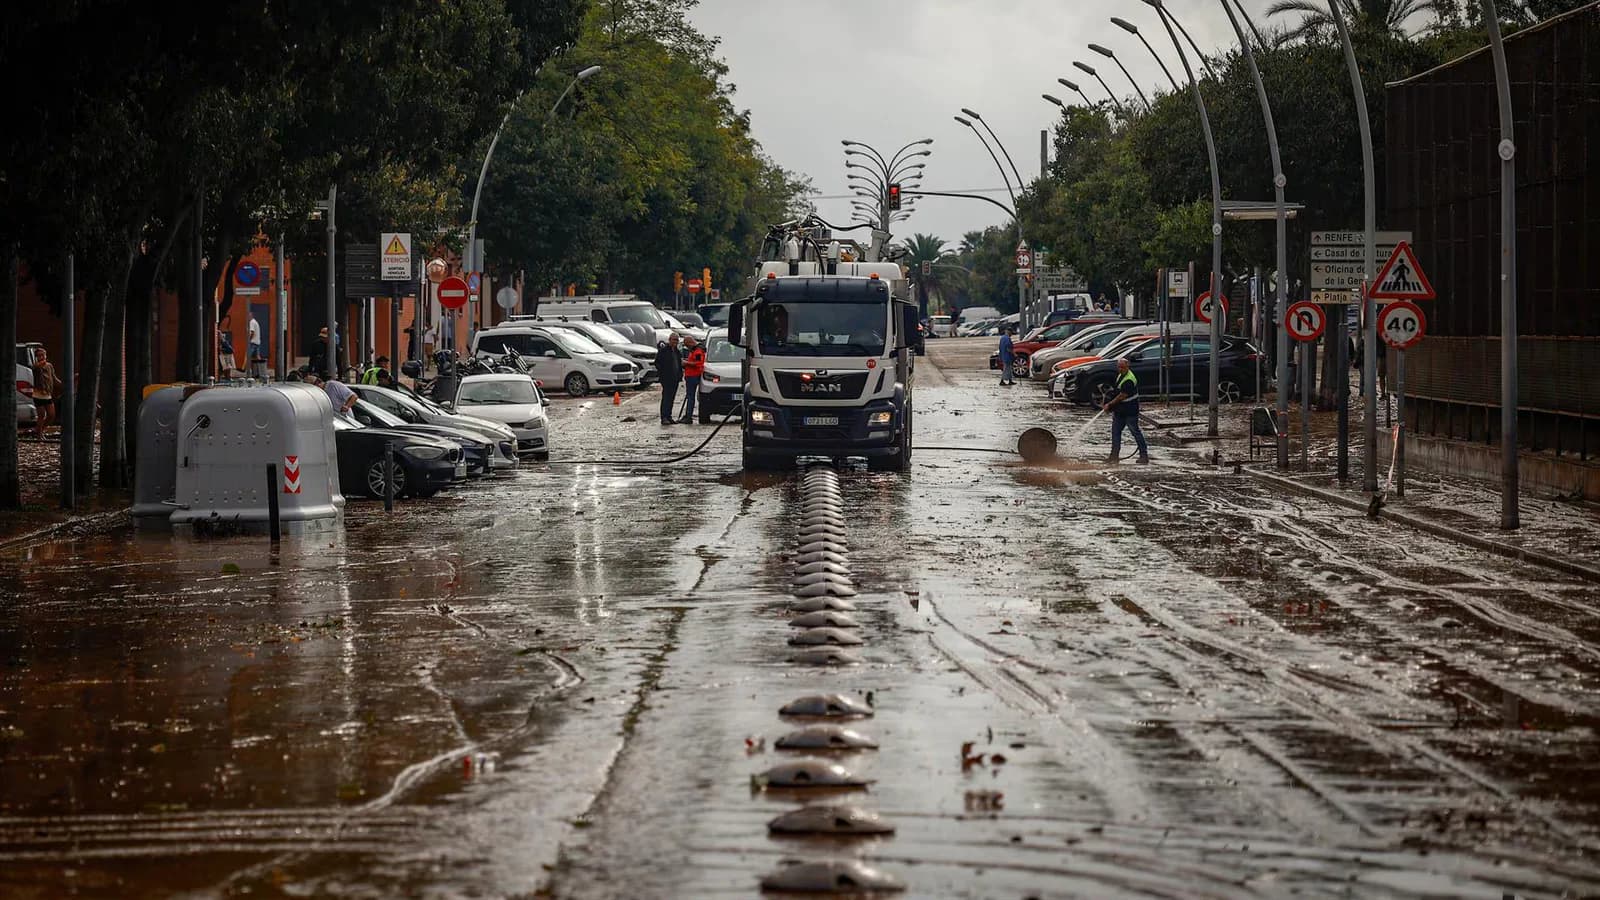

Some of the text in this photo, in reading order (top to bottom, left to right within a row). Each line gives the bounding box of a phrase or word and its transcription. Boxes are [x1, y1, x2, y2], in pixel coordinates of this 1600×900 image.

[1325, 233, 1353, 242] RENFE
[1325, 249, 1348, 257] Casal
[1350, 249, 1360, 257] de
[1325, 263, 1354, 273] Oficina
[1325, 276, 1335, 285] de
[1337, 276, 1345, 285] la
[1324, 292, 1347, 303] Platja
[1387, 317, 1416, 333] 40
[800, 383, 842, 392] MAN
